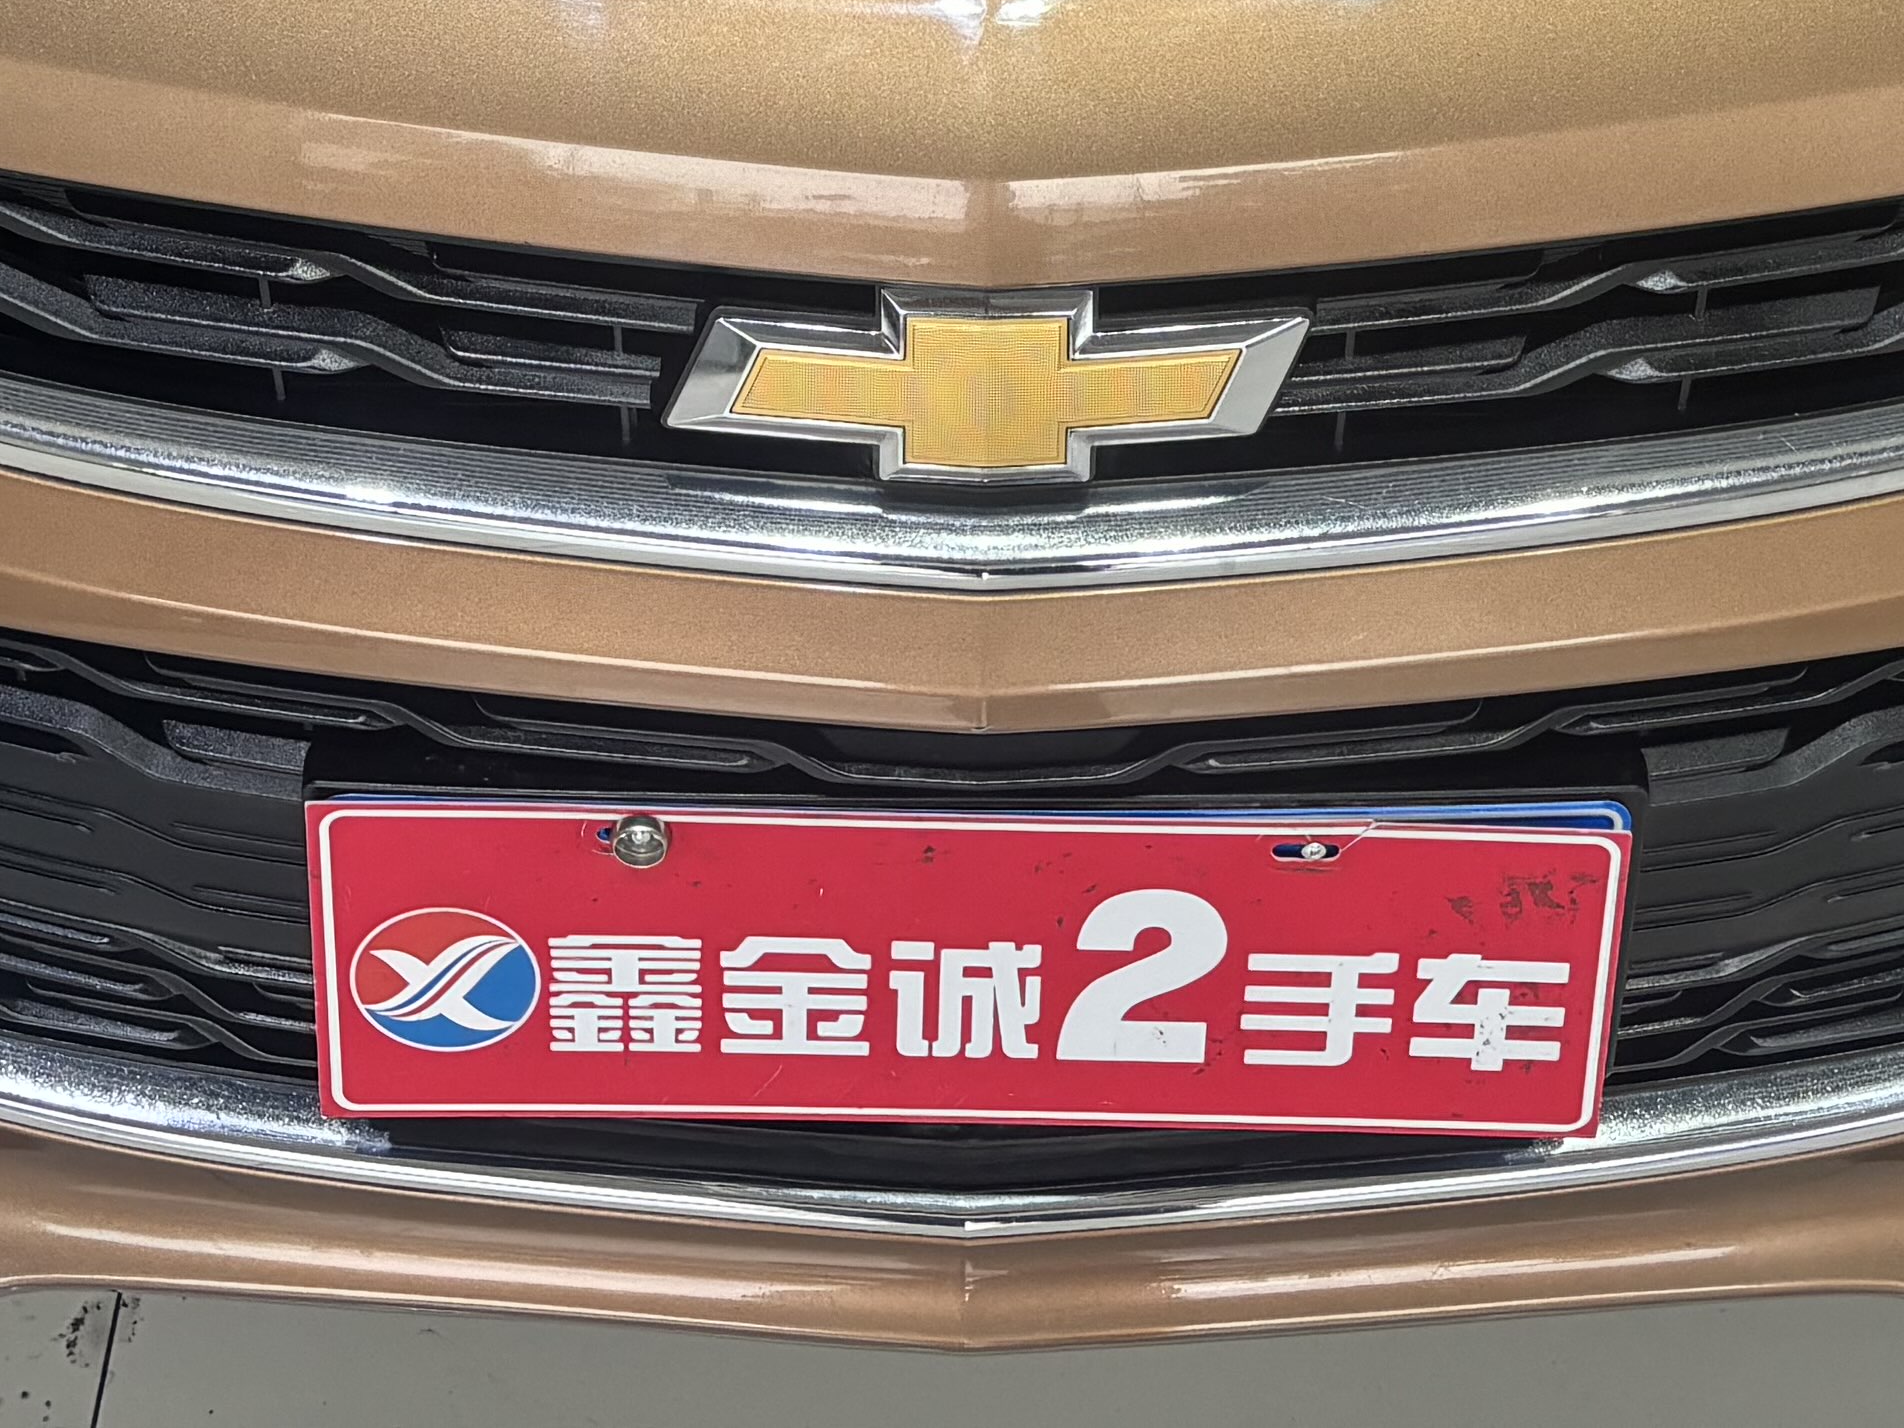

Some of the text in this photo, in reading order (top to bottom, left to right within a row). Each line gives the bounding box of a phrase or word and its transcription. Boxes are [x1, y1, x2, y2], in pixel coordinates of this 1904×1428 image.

[547, 888, 1569, 1072] 鑫金诚2手车
